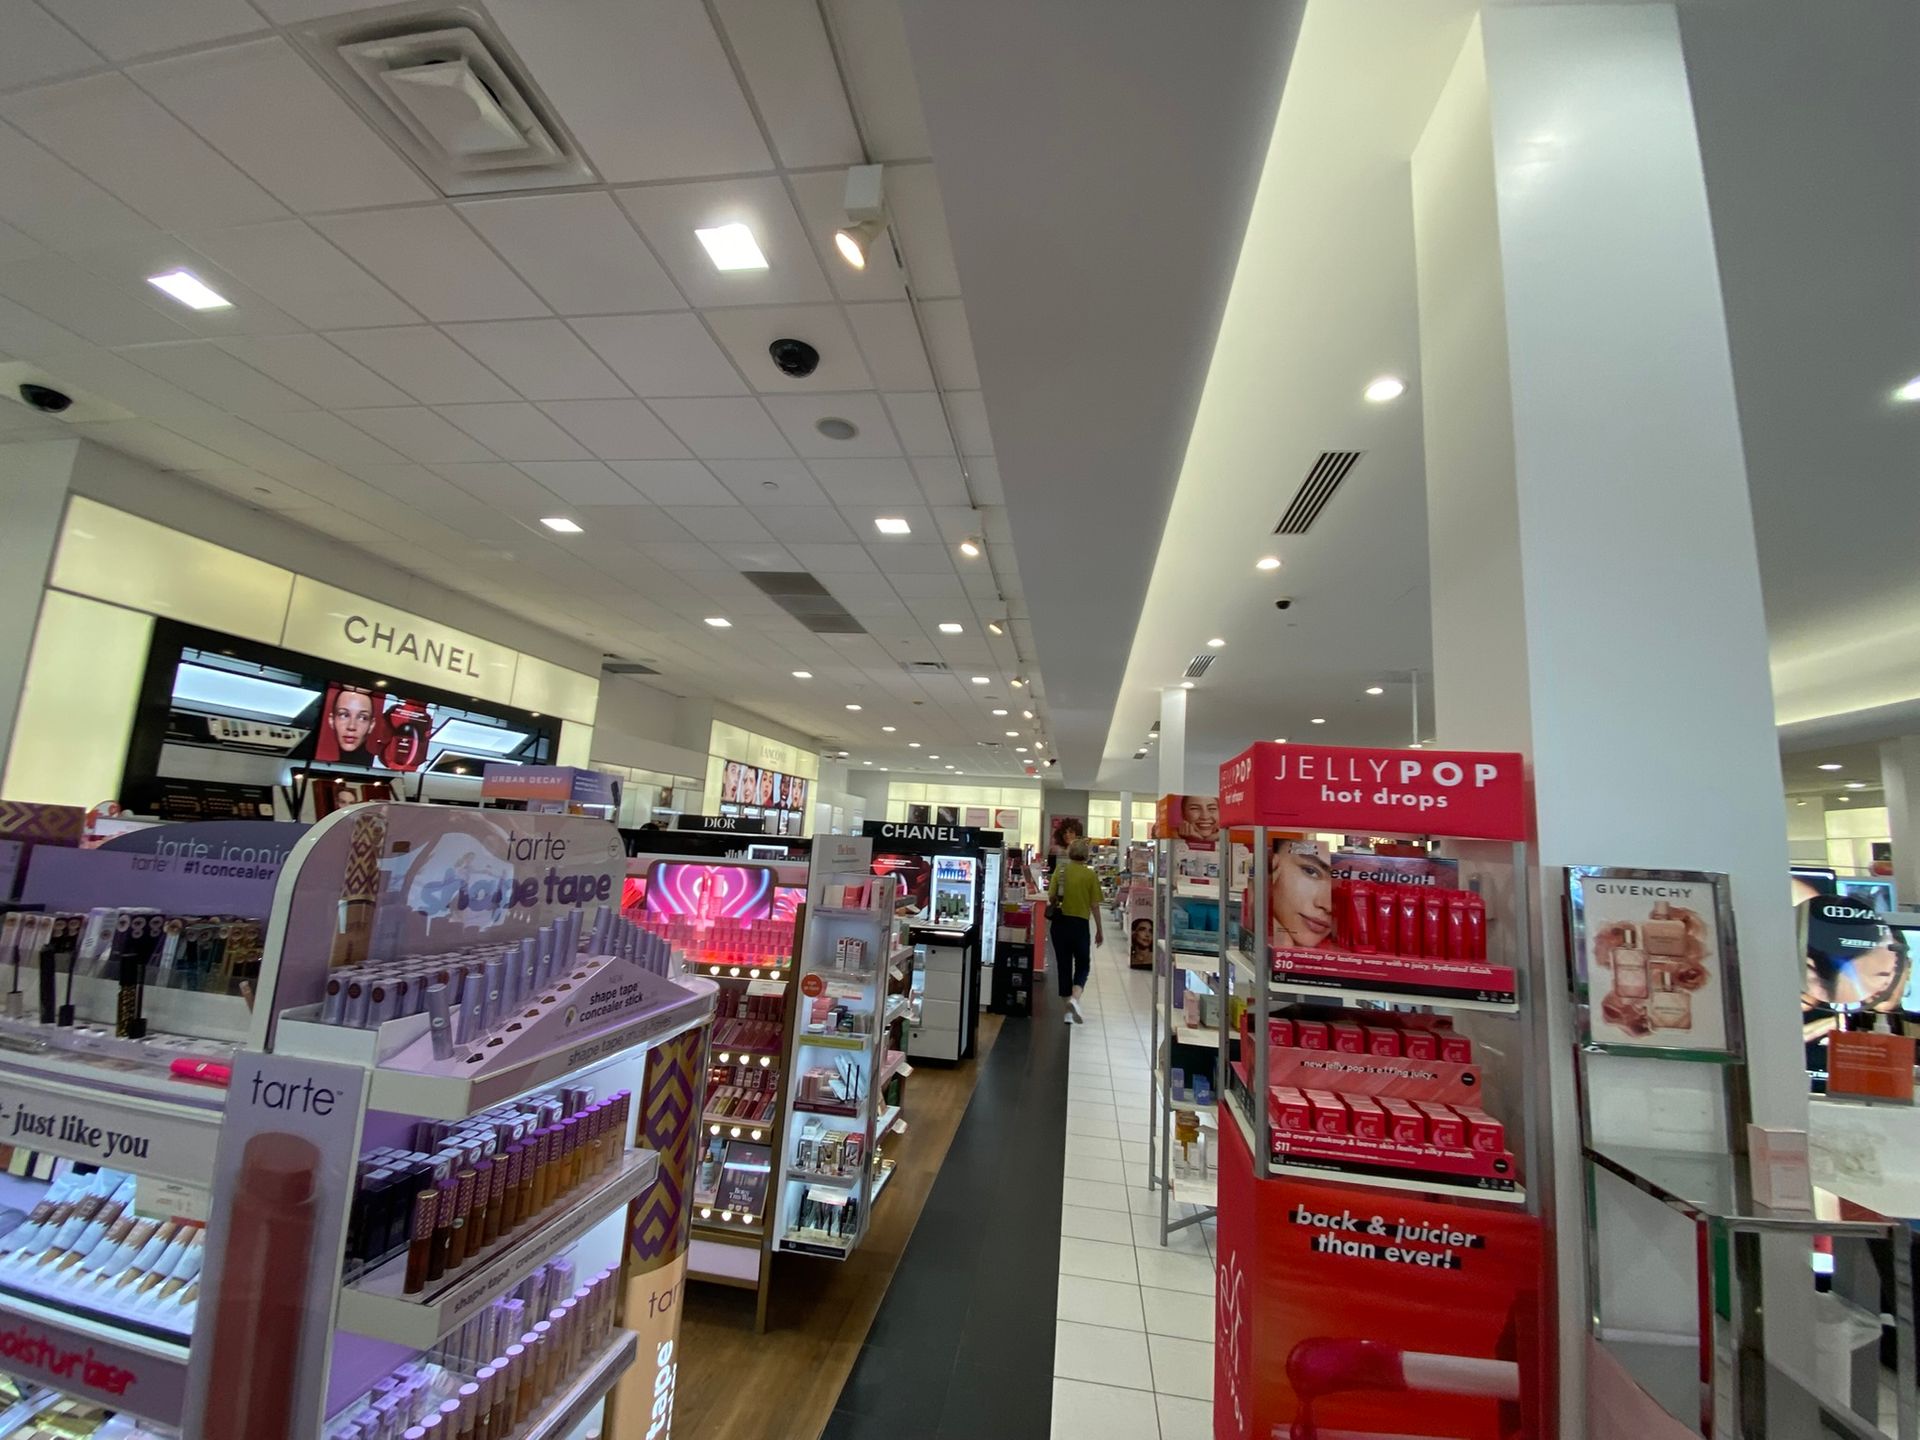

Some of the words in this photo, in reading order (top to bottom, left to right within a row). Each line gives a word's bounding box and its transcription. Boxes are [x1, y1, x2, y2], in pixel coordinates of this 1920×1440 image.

[344, 615, 480, 679] CHANEL
[491, 775, 526, 784] URBAN
[529, 776, 563, 785] DECAY
[1321, 784, 1363, 804] hot
[1373, 787, 1449, 811] drops
[703, 816, 736, 830] DIOR
[881, 823, 960, 842] CHANEL
[156, 834, 209, 859] tarte
[507, 830, 566, 862] tarte
[130, 855, 168, 873] tarte
[201, 863, 275, 881] concealer
[543, 866, 612, 908] tape
[1595, 882, 1693, 900] GIVENCHY
[1274, 959, 1294, 970] $10
[1293, 952, 1324, 962] makeup
[579, 1000, 624, 1022] concealer
[624, 991, 644, 1008] stick
[589, 988, 618, 1006] shape
[619, 982, 639, 997] tape
[1303, 1060, 1324, 1069] new
[1347, 1065, 1365, 1075] pop
[250, 1069, 338, 1117] tarte
[10, 1103, 57, 1138] just
[58, 1115, 103, 1148] like
[102, 1131, 150, 1159] you
[1293, 1133, 1316, 1143] away
[1316, 1136, 1347, 1147] makeup
[1274, 1141, 1291, 1153] $11
[1296, 1203, 1358, 1233] back
[1366, 1215, 1387, 1237] &
[1395, 1217, 1478, 1248] juicier
[1317, 1232, 1376, 1260] than
[1385, 1248, 1452, 1270] ever!
